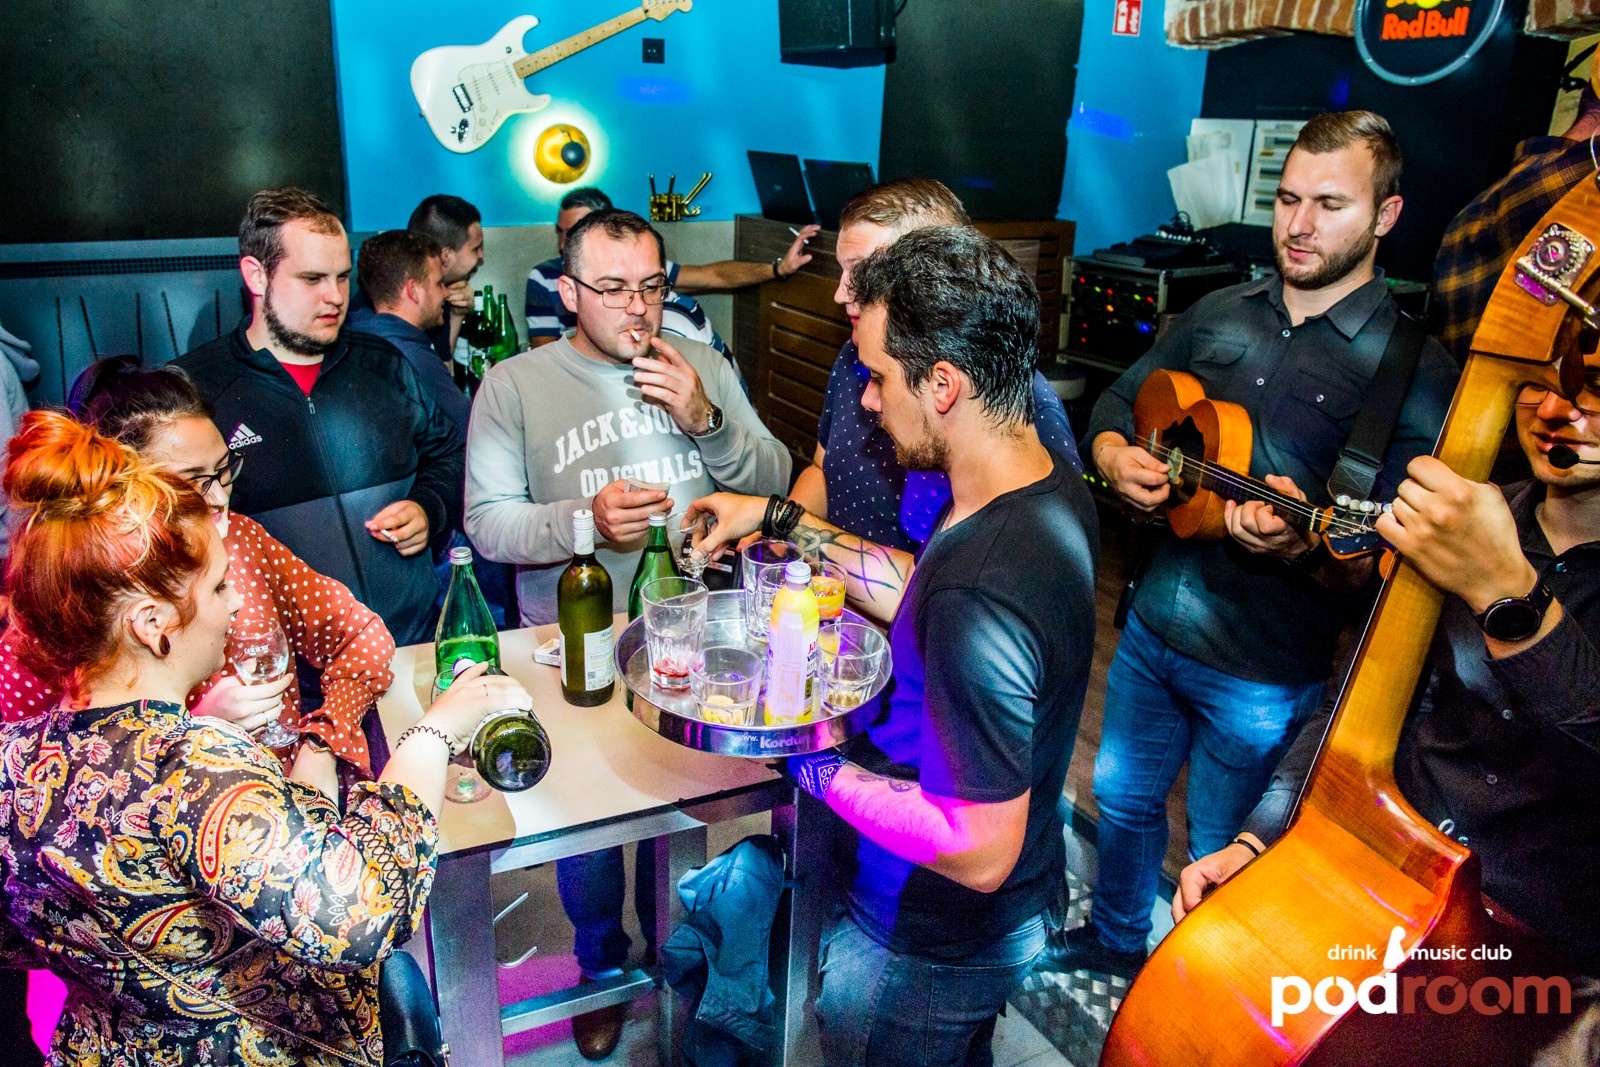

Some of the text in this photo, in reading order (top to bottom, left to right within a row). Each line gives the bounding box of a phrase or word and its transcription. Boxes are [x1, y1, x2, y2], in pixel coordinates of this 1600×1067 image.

[1382, 6, 1470, 40] Red Bull
[228, 435, 263, 450] adidas
[553, 404, 683, 474] JACK&JO
